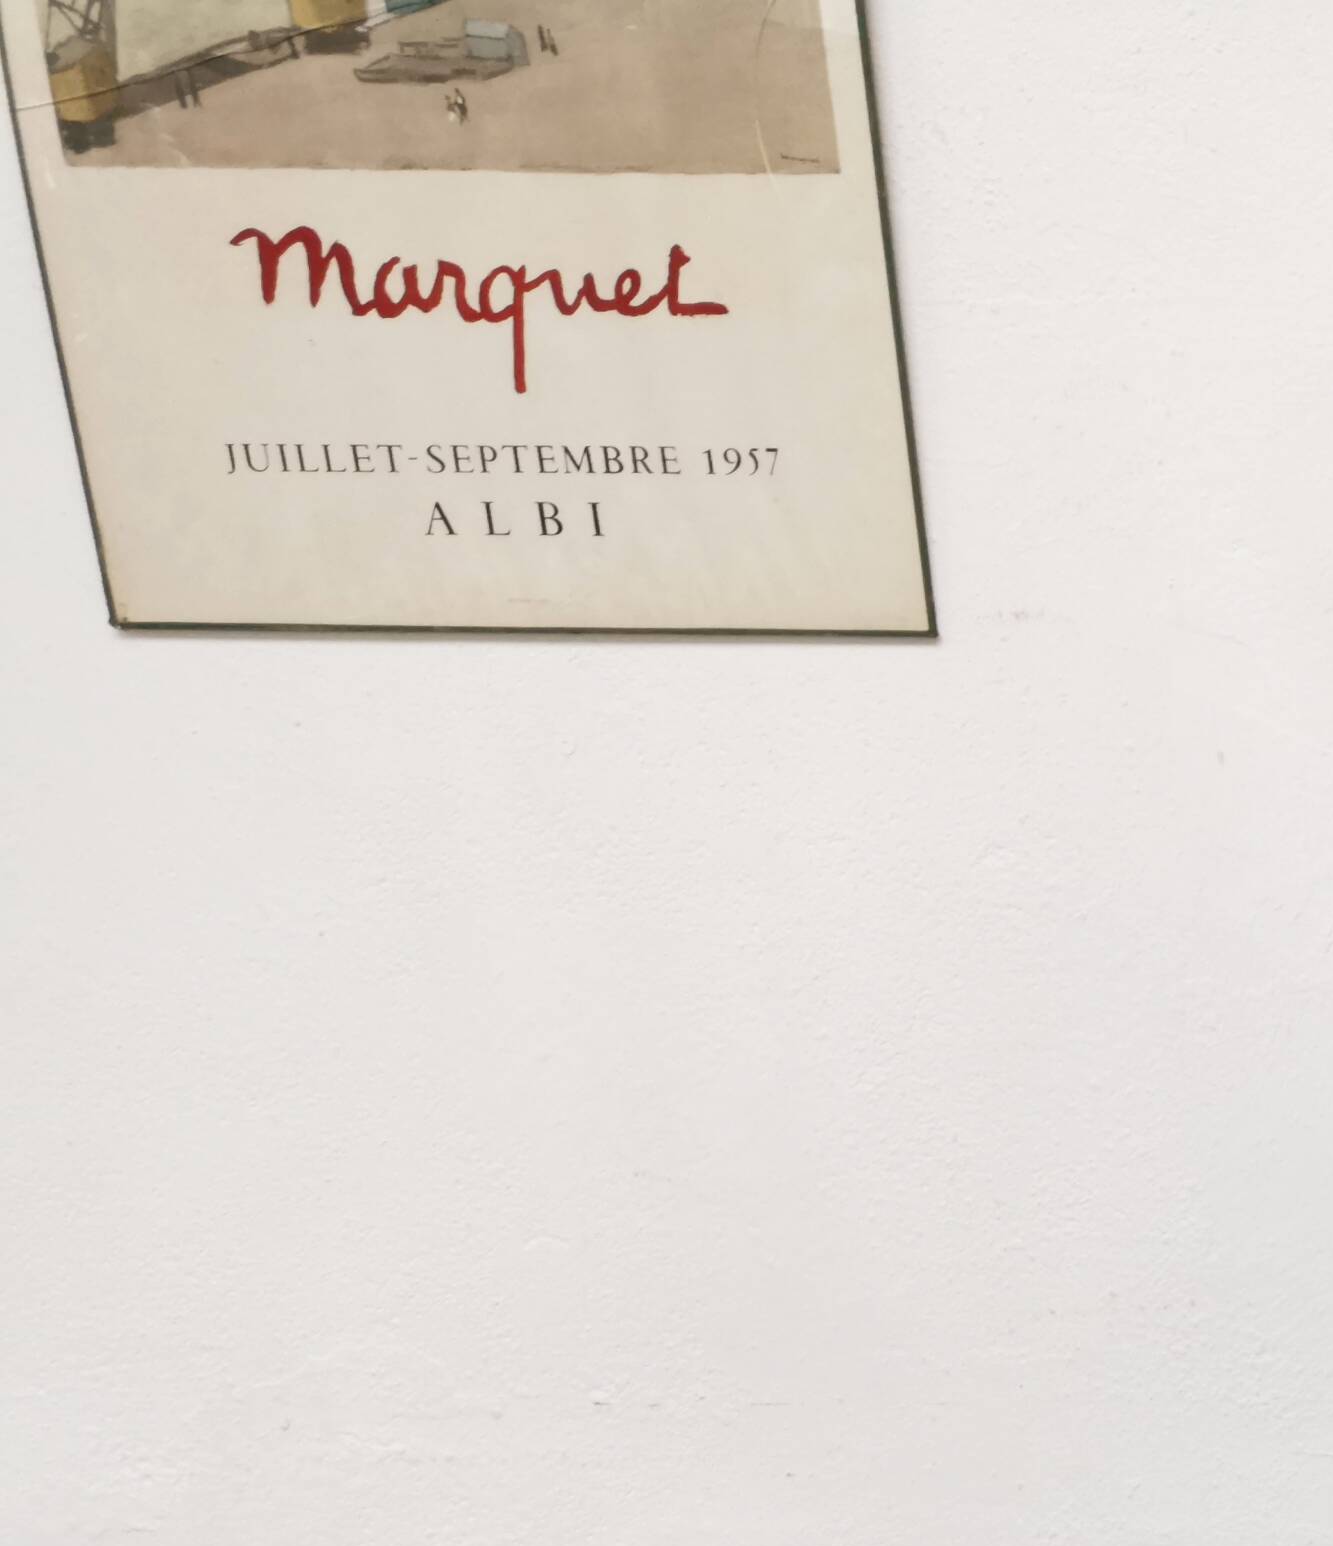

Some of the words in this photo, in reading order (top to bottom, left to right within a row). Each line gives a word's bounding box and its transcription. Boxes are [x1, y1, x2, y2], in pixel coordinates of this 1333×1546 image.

[225, 442, 682, 476] JUILLET-SEPTEMBRE
[702, 446, 780, 476] 1957
[425, 500, 606, 537] ALBI
